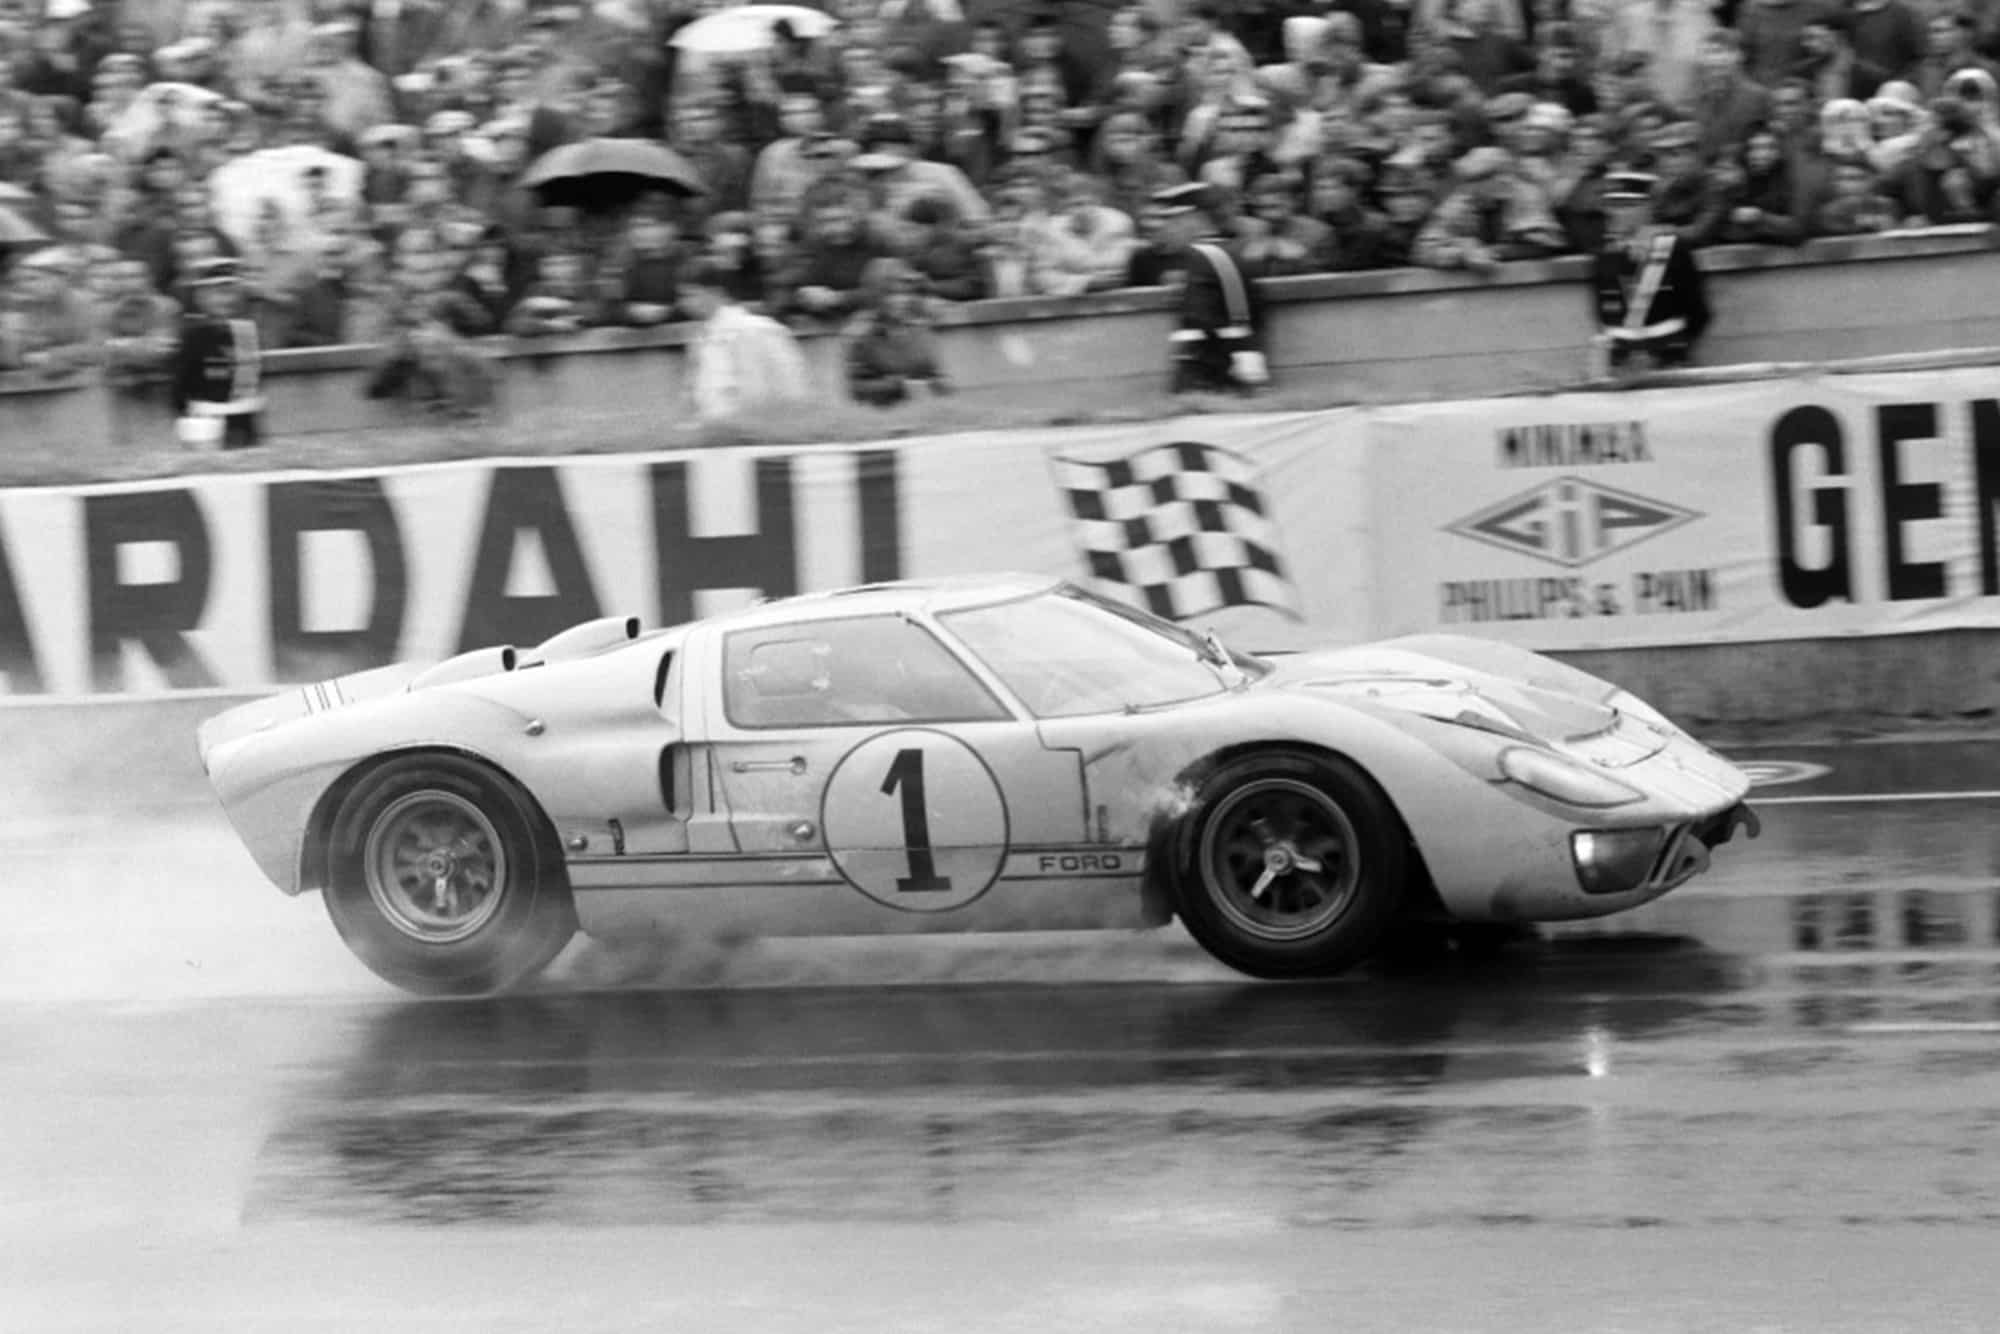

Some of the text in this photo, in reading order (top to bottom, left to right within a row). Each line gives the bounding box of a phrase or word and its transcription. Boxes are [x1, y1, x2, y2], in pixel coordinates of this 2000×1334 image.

[0, 450, 901, 693] RDAH
[880, 749, 951, 891] 1
[1039, 855, 1121, 872] FORD
